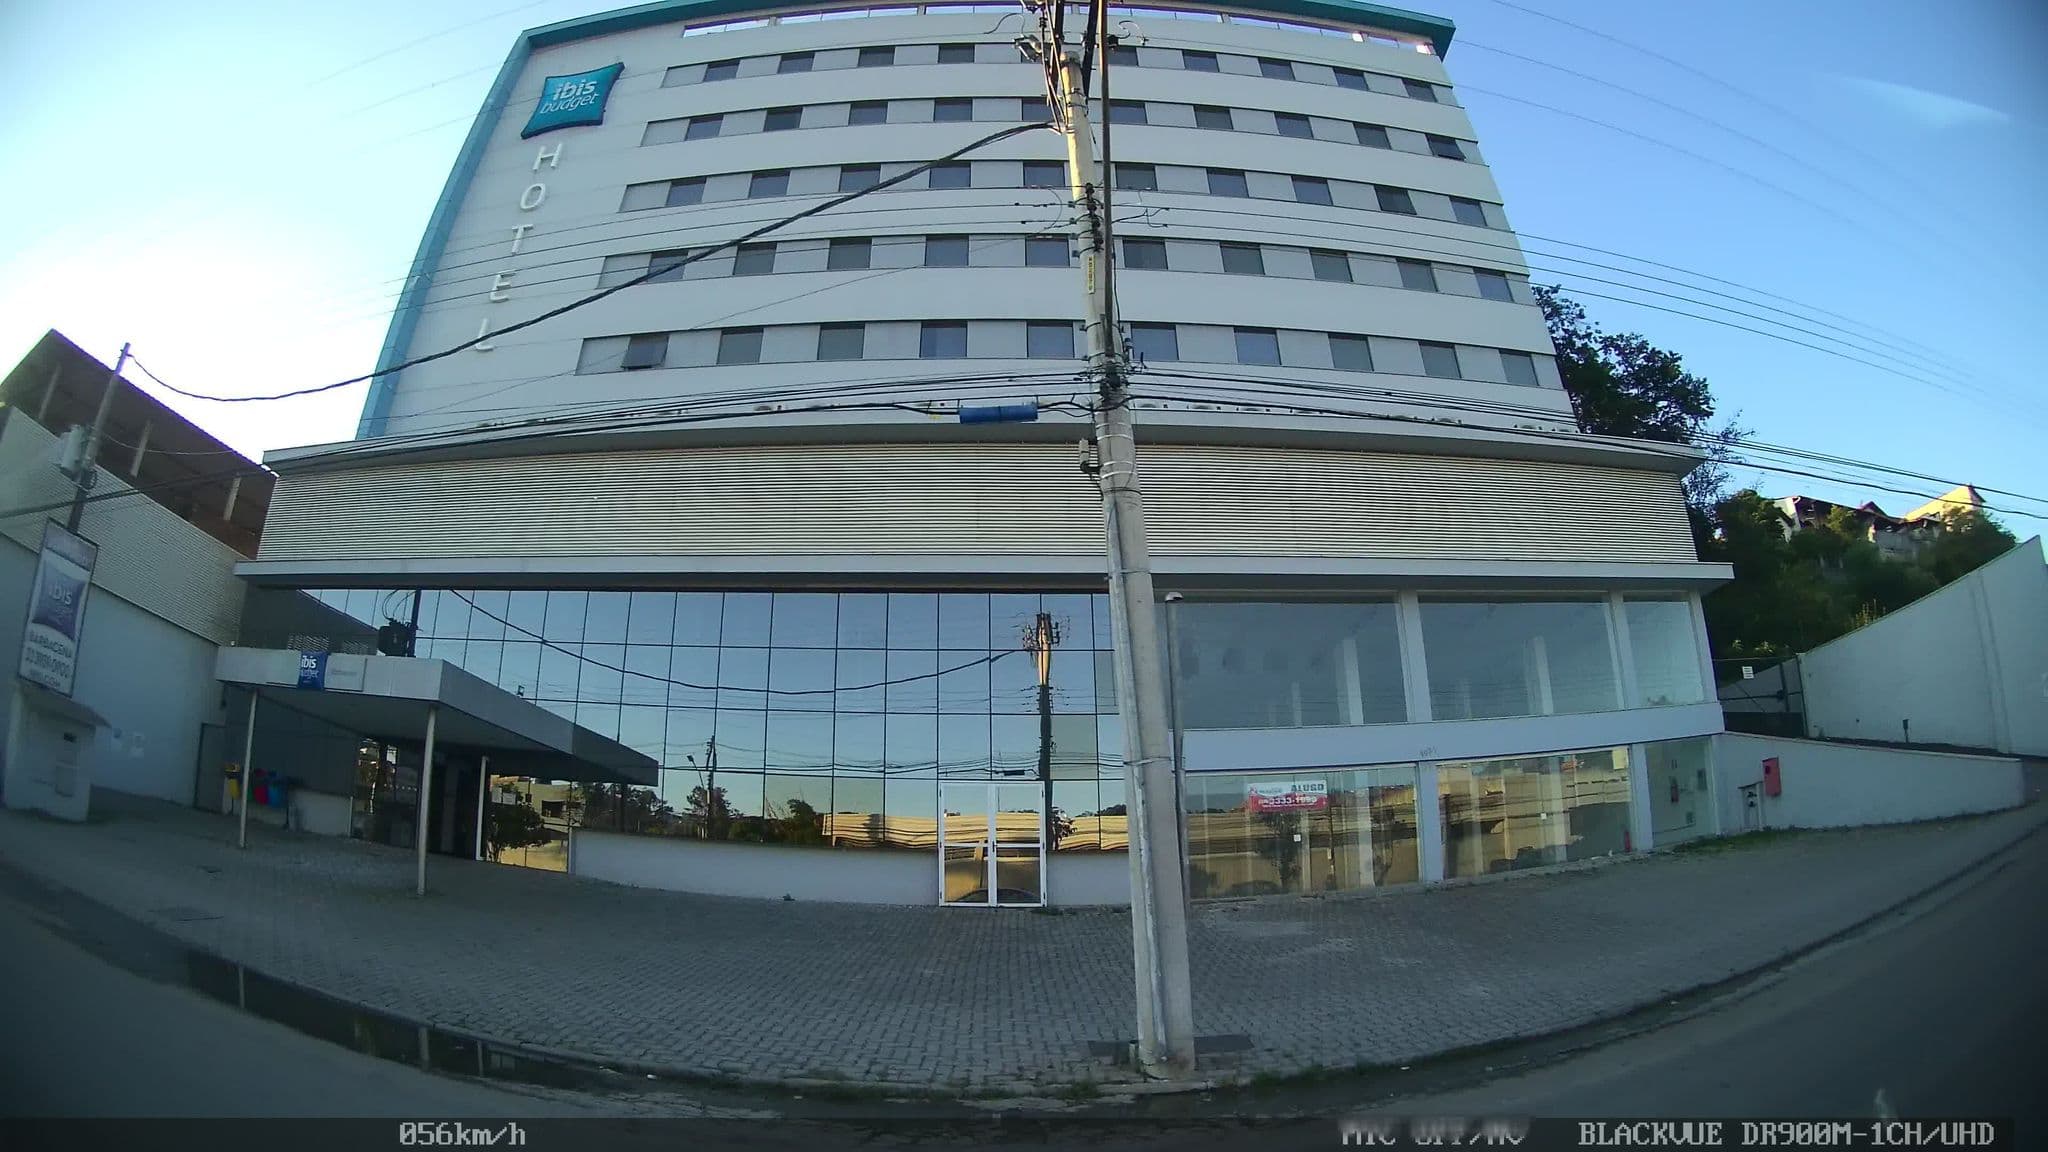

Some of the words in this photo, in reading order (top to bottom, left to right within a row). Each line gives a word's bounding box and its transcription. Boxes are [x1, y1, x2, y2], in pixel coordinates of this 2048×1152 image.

[553, 79, 597, 100] ibis
[540, 93, 599, 113] budget
[475, 143, 562, 351] HOTEL
[301, 655, 316, 669] ibis
